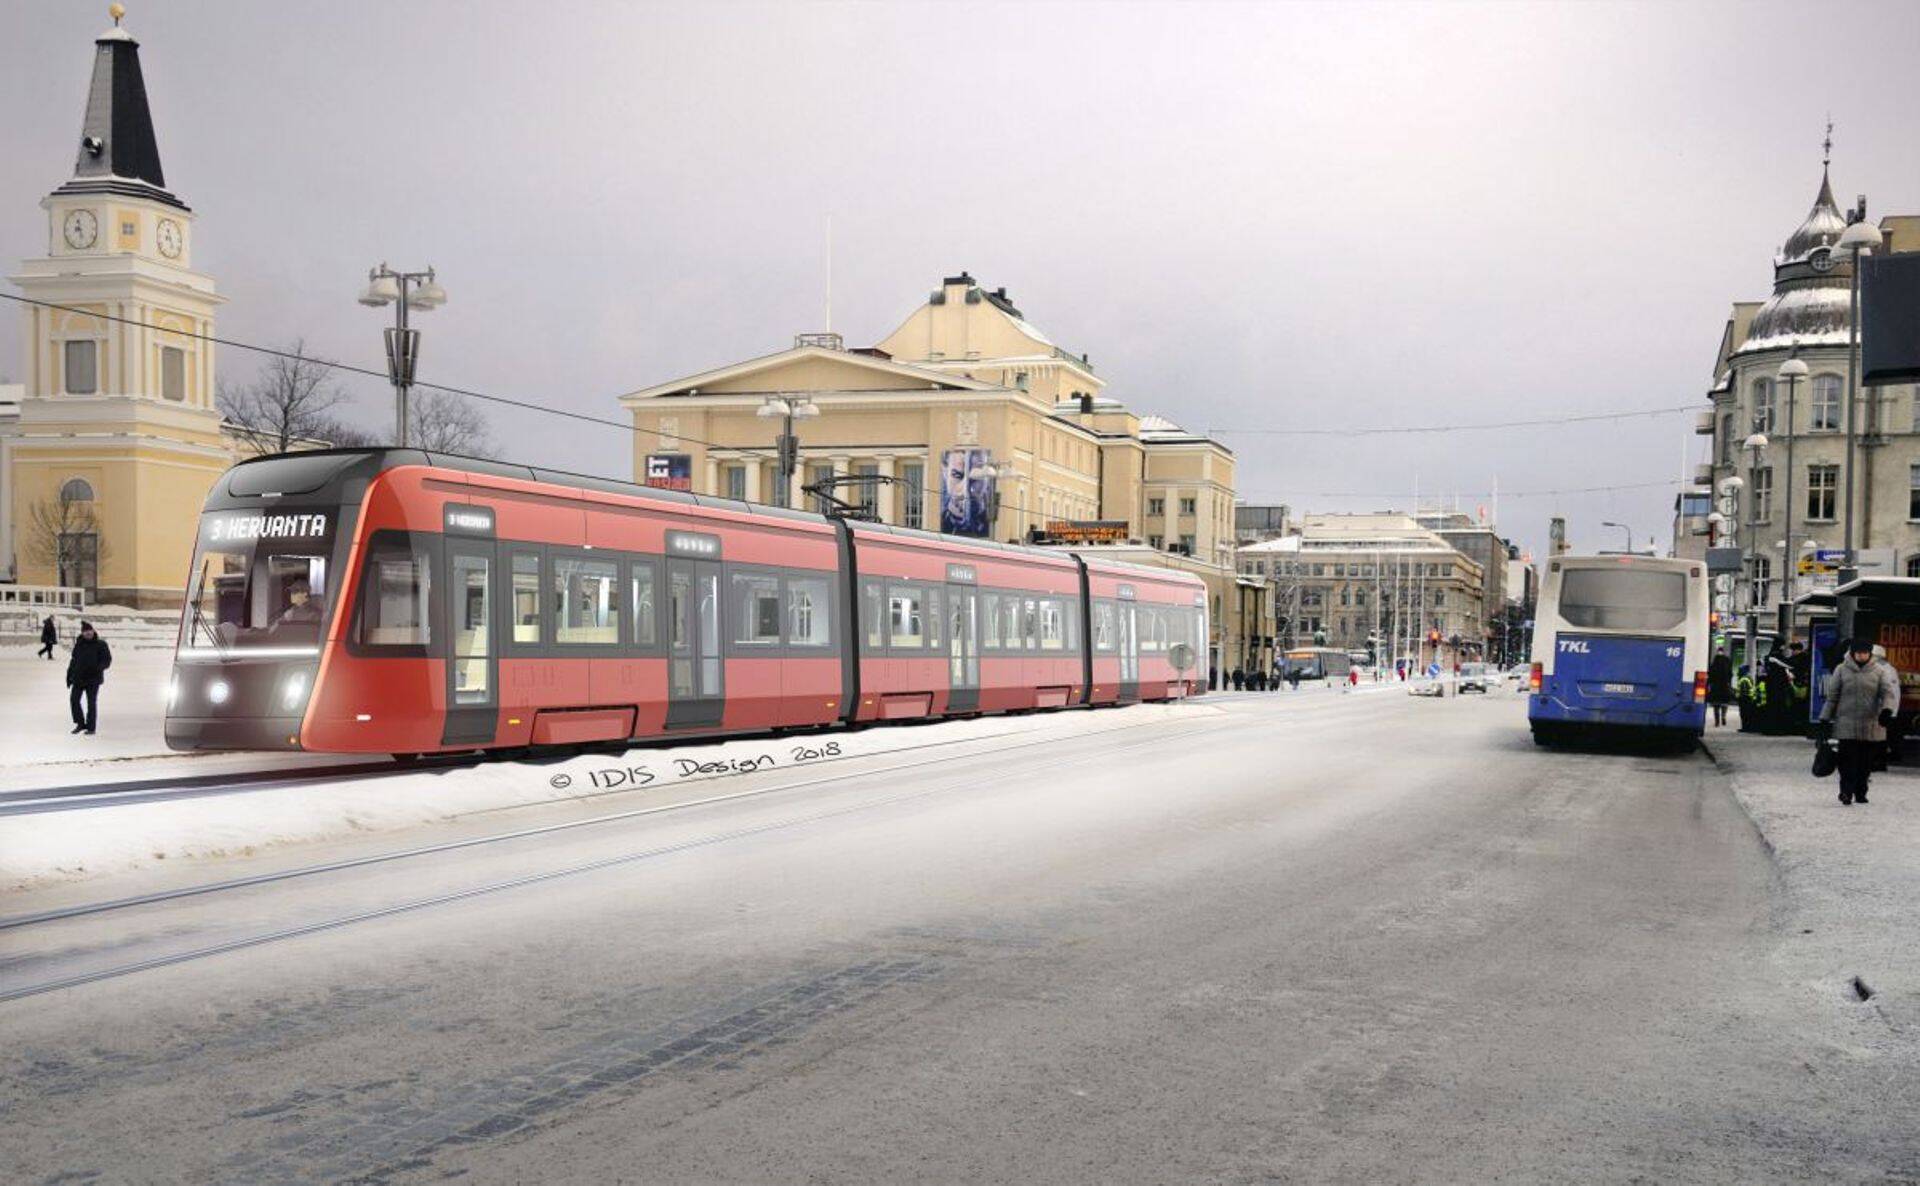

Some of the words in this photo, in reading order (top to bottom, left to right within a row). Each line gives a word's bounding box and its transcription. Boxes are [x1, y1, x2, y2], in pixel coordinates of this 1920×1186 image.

[210, 519, 223, 540] 3
[227, 514, 327, 540] HERVANTA
[1559, 640, 1591, 653] TKL
[1666, 646, 1681, 657] 16
